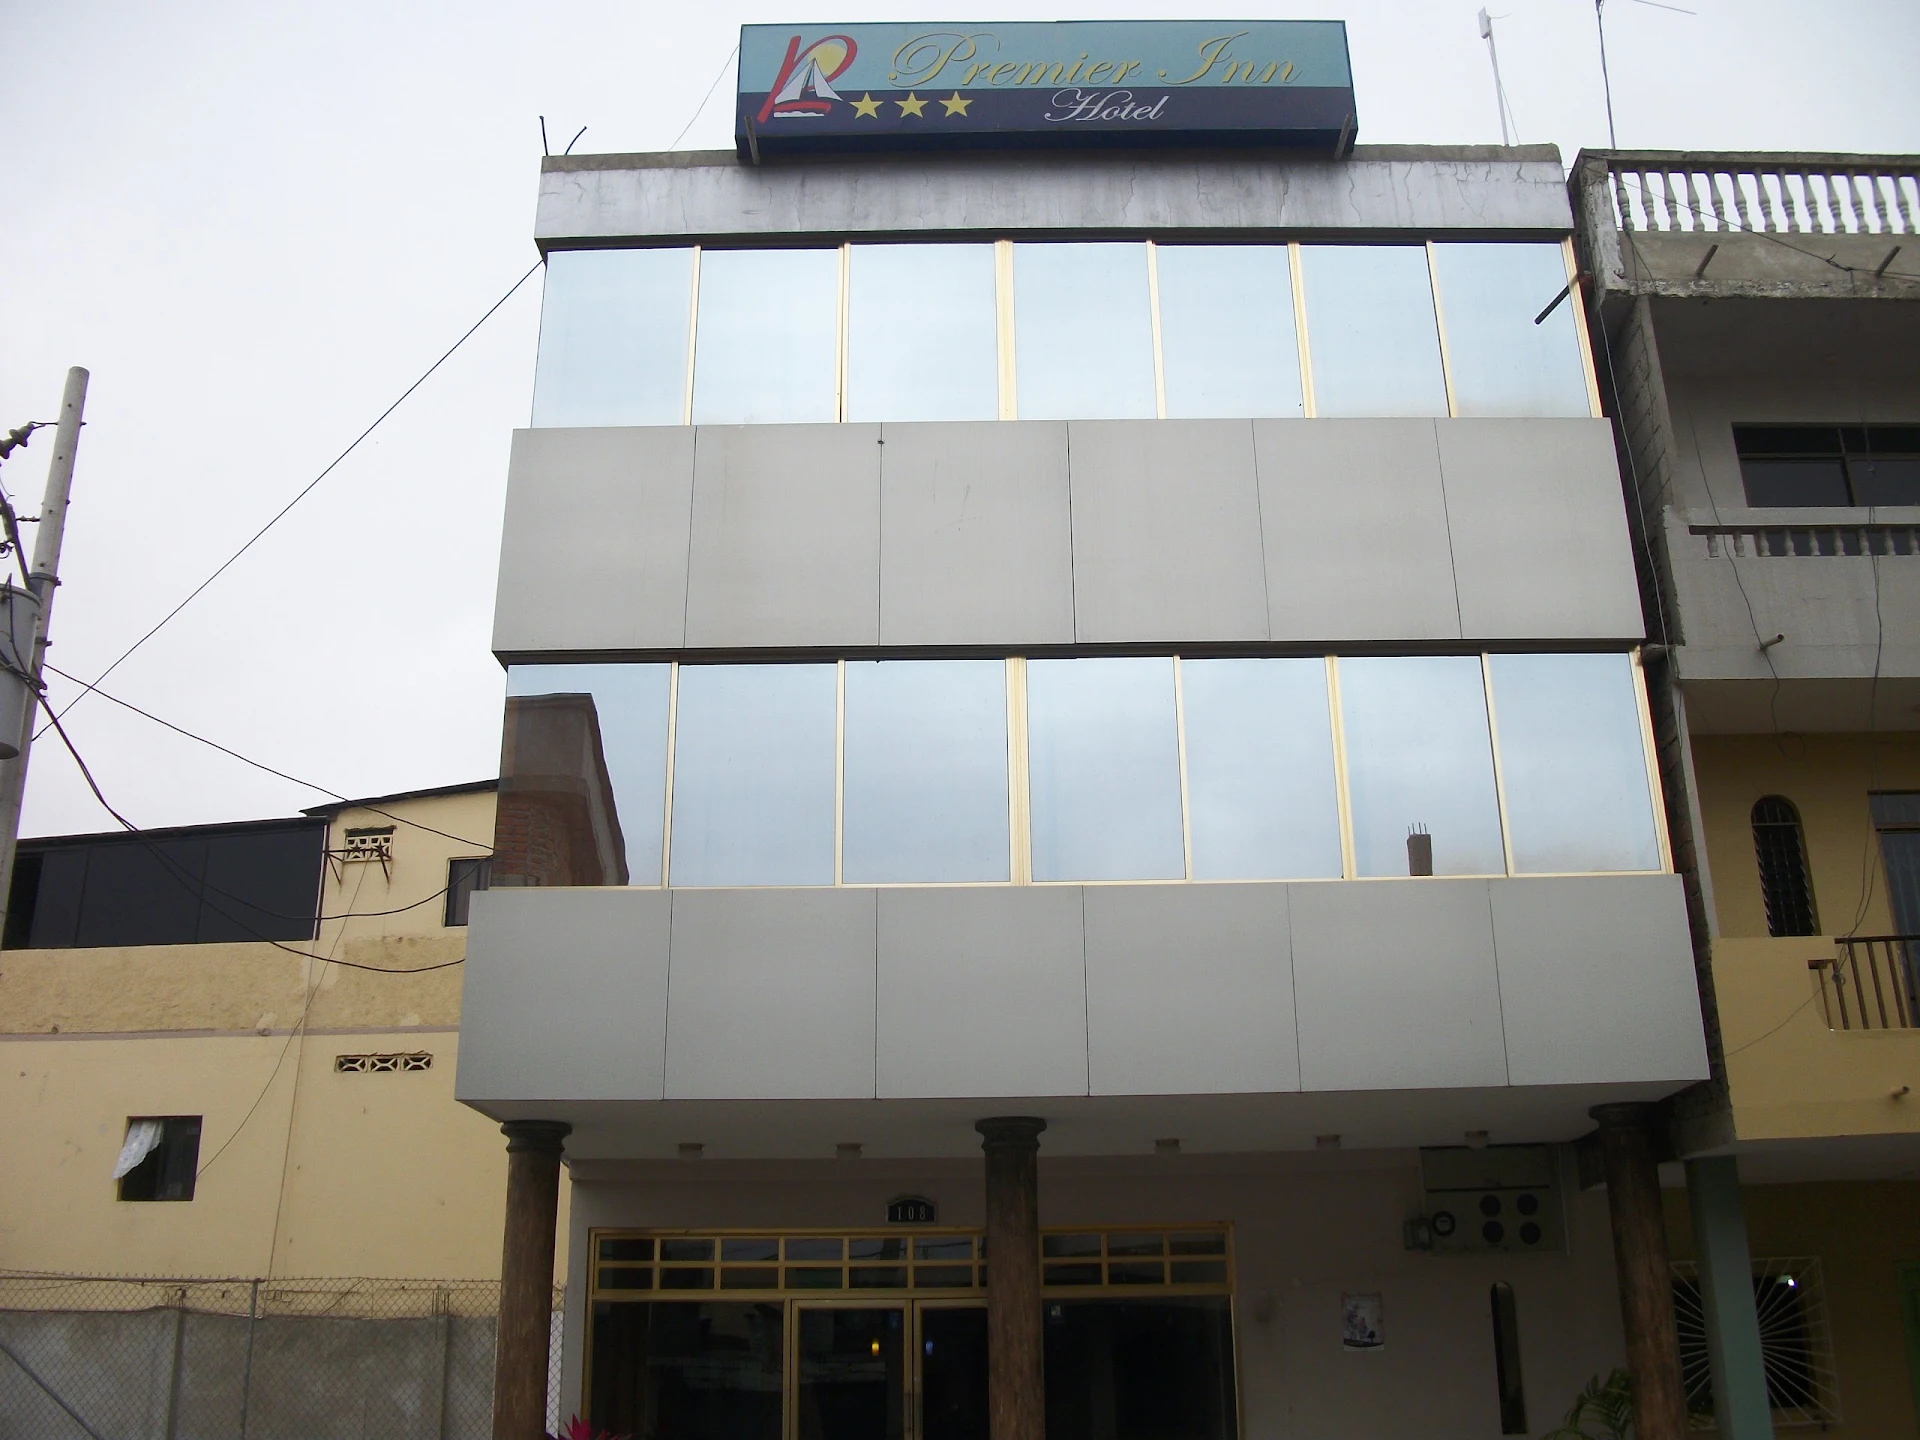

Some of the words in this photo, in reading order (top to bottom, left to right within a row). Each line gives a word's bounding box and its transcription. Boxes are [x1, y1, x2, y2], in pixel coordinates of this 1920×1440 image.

[889, 32, 1143, 88] Premier
[1157, 31, 1301, 86] Inn
[1044, 89, 1169, 123] Hotel
[898, 1206, 925, 1220] 108
